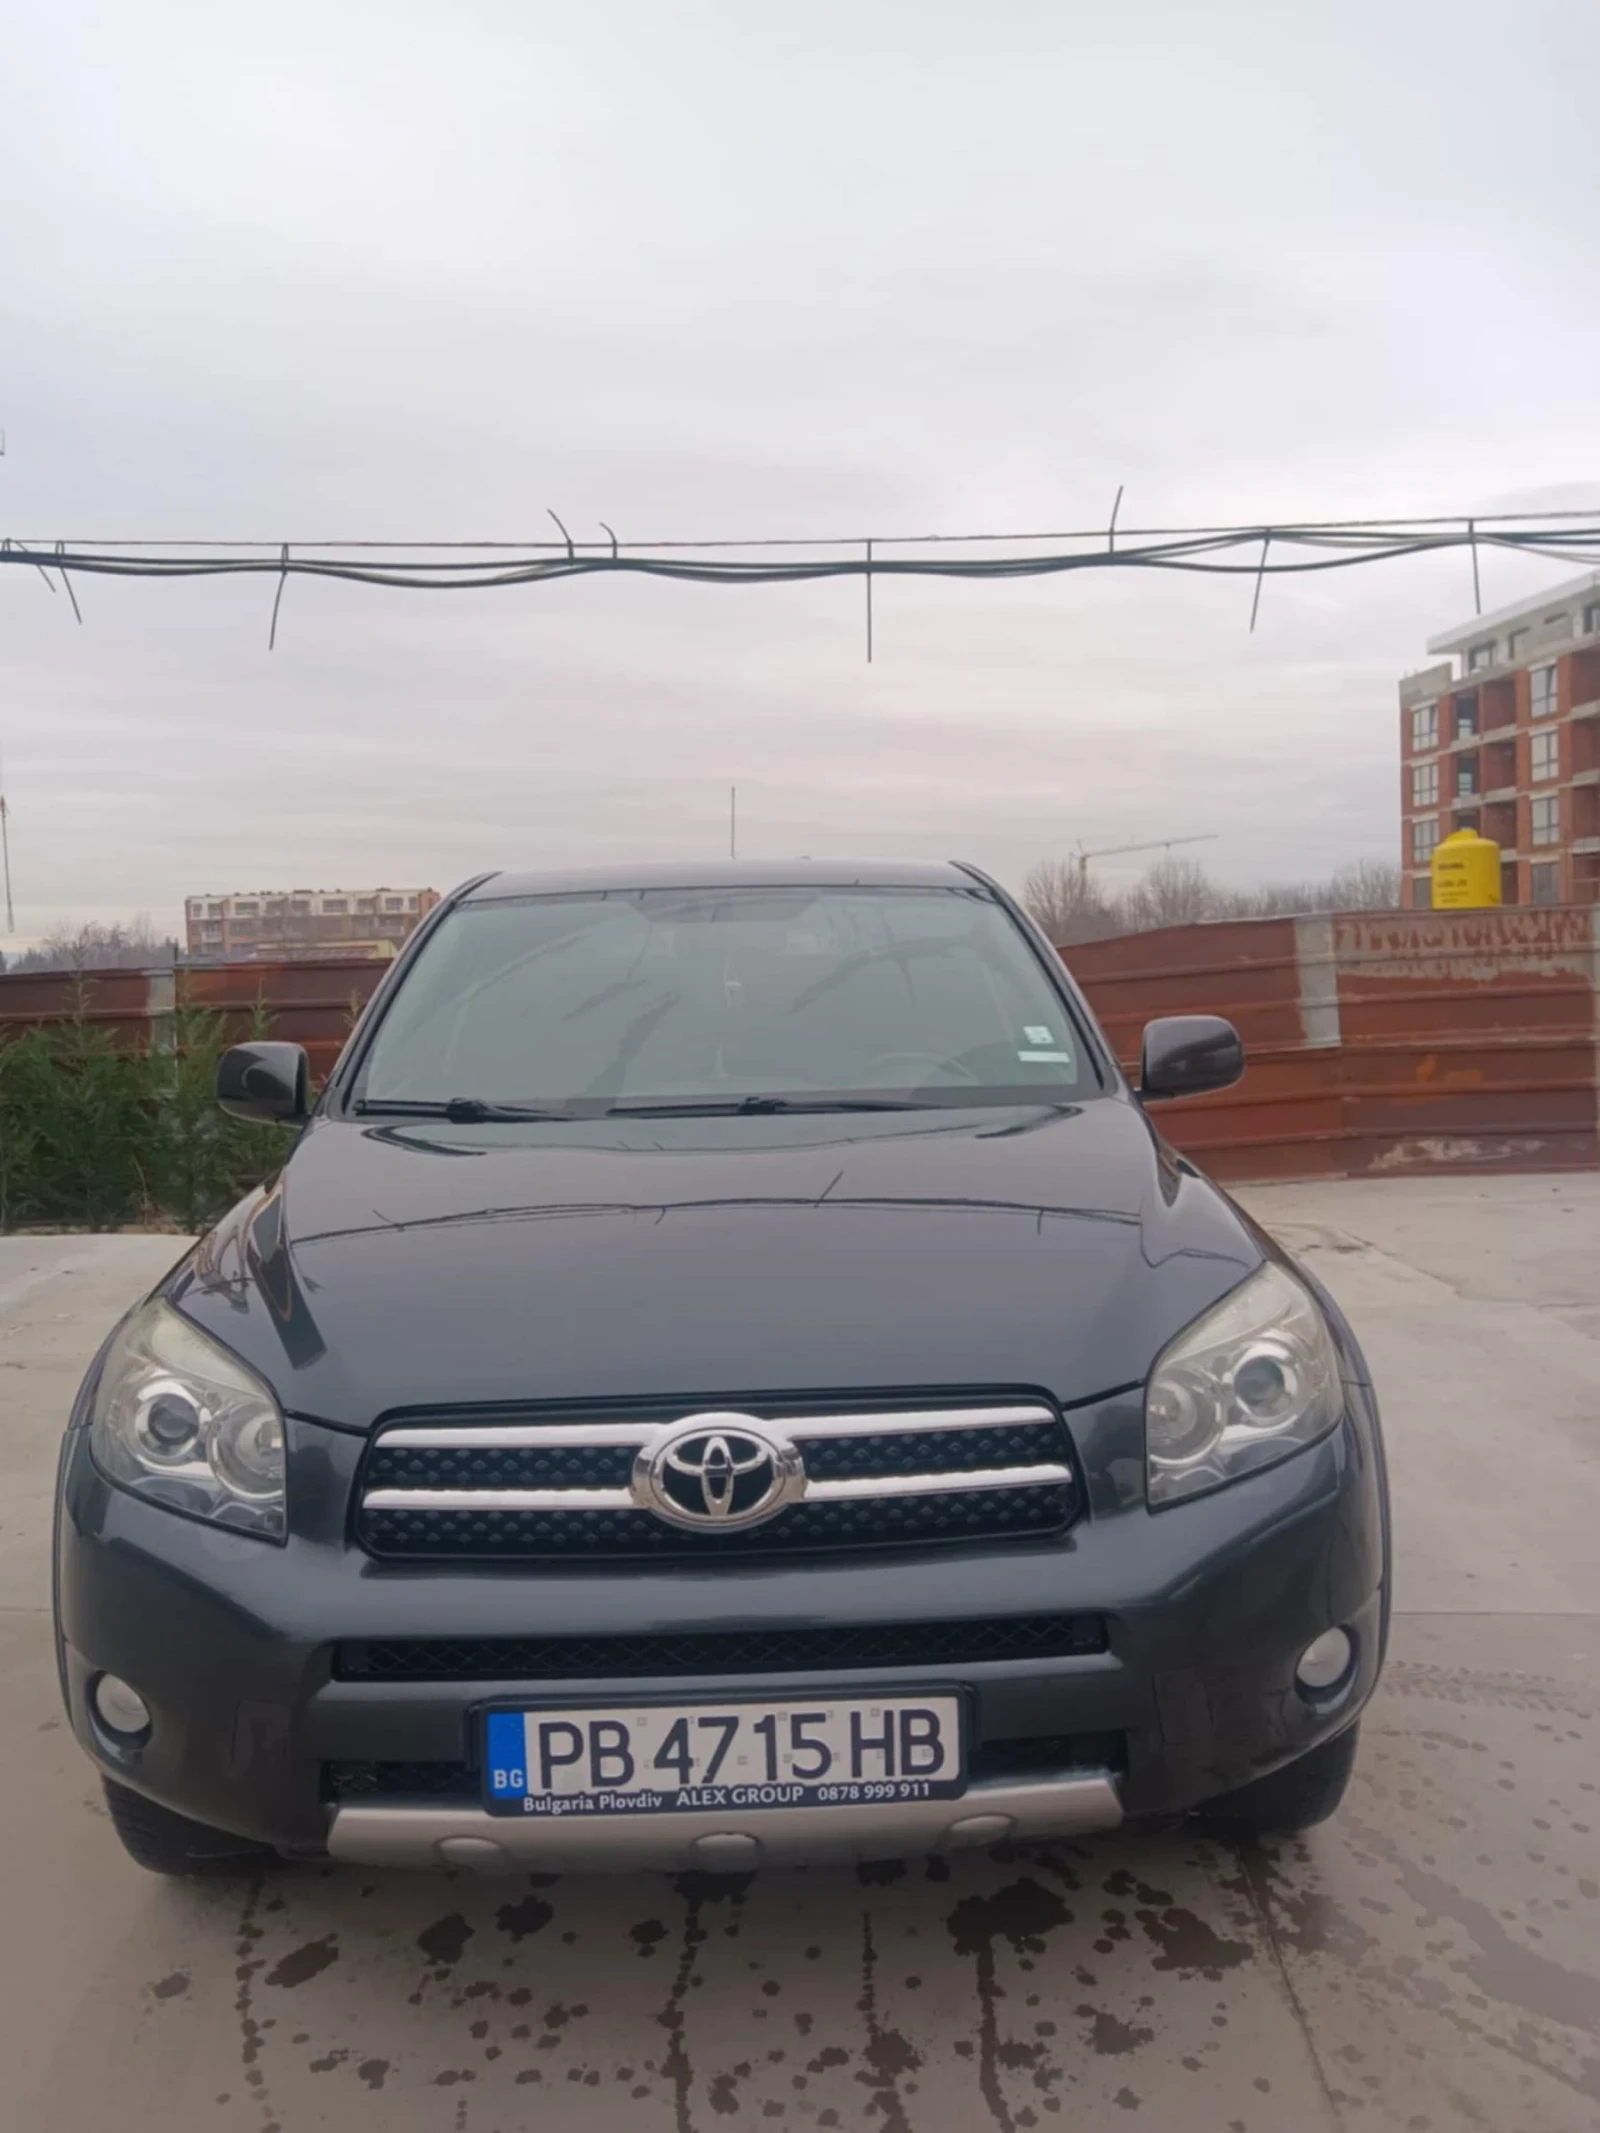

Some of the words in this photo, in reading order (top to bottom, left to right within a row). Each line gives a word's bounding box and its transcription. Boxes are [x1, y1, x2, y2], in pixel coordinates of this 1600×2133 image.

[539, 1720, 634, 1789] PB
[653, 1713, 832, 1784] 4715
[850, 1709, 944, 1778] HB
[493, 1769, 524, 1789] BG
[523, 1796, 594, 1814] Bulgaria
[599, 1793, 662, 1809] Plovdiv
[676, 1788, 727, 1806] ALEX
[731, 1786, 804, 1804] GROUP
[818, 1785, 860, 1800] 0878
[864, 1784, 896, 1799] 999
[900, 1783, 930, 1797] 911
